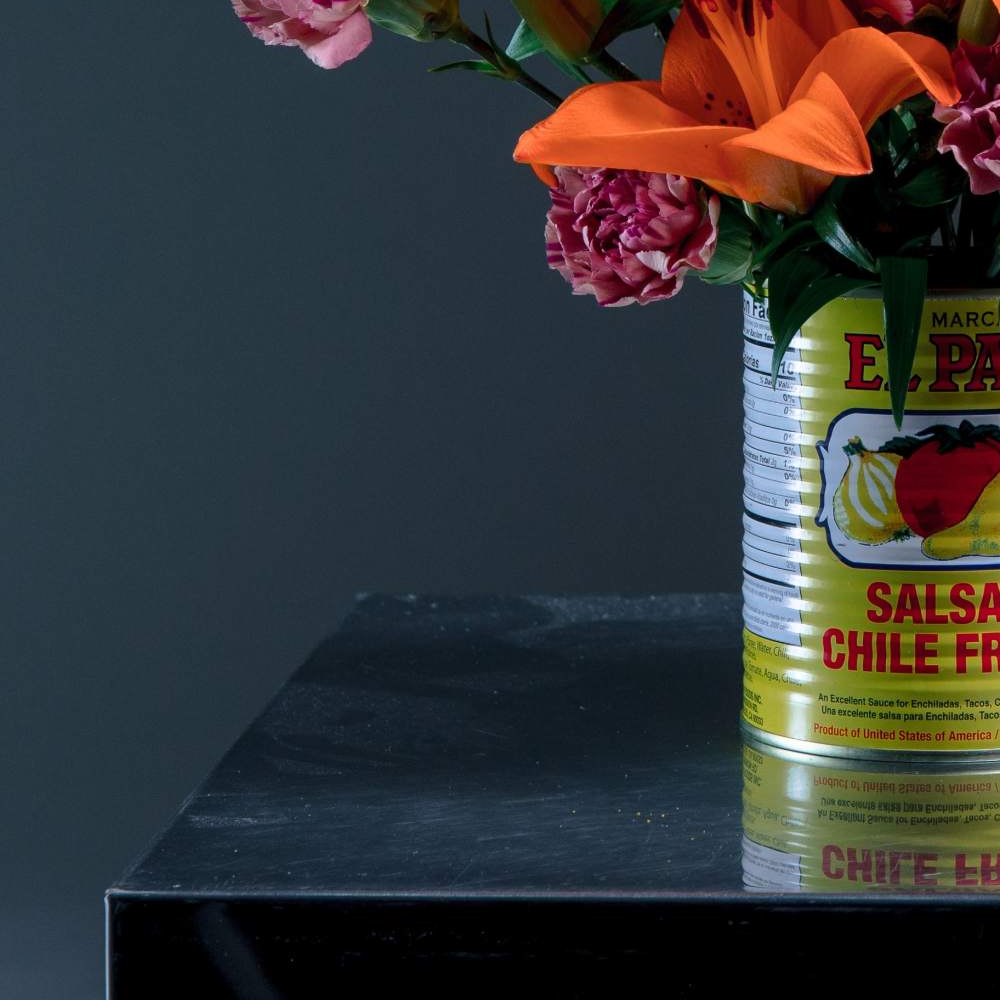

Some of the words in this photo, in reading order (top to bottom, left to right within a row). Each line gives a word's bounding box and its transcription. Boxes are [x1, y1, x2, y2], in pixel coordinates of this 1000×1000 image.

[932, 312, 1000, 328] MARC
[822, 627, 939, 674] CHILE
[818, 693, 828, 701] An
[830, 694, 866, 706] Excellent
[868, 697, 894, 707] Sauce
[896, 698, 909, 708] for
[911, 699, 962, 710] Enchiladas,
[966, 698, 992, 709] Tacos,
[821, 706, 836, 716] Una
[837, 707, 876, 719] excelente
[878, 711, 901, 720] salsa
[903, 713, 923, 723] para
[925, 711, 977, 722] Enchiladas,
[814, 723, 849, 737] Product
[851, 727, 861, 738] of
[863, 728, 896, 740] United
[899, 730, 931, 741] States
[935, 730, 946, 741] of
[950, 729, 992, 741] America
